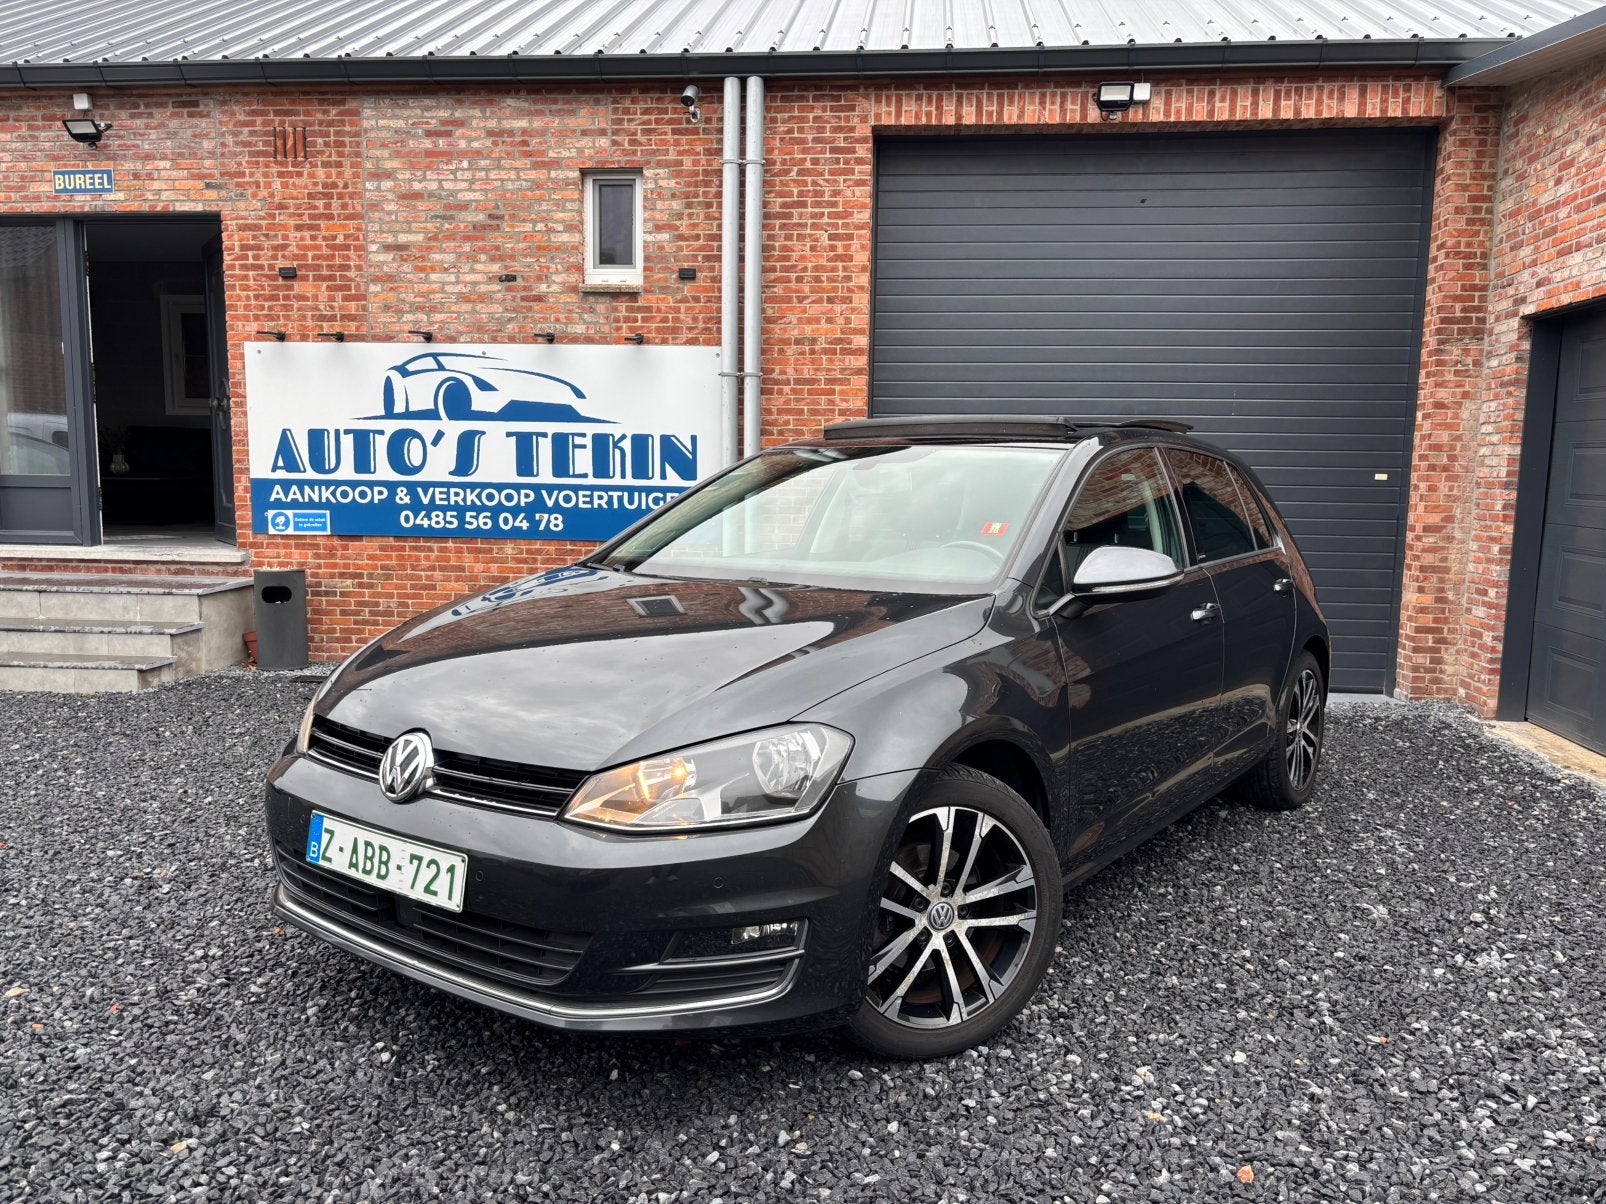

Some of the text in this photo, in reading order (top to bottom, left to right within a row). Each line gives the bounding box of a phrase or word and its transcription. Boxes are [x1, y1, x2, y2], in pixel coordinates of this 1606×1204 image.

[54, 173, 112, 190] BUREEL
[270, 427, 698, 482] AUTO'S TEKIN
[269, 484, 389, 504] AANKOOP
[395, 486, 411, 505] &
[416, 487, 536, 507] VERKOOP
[400, 510, 564, 531] 0485 56 04 78
[309, 841, 319, 858] B
[320, 826, 457, 902] Z-ABB-721
